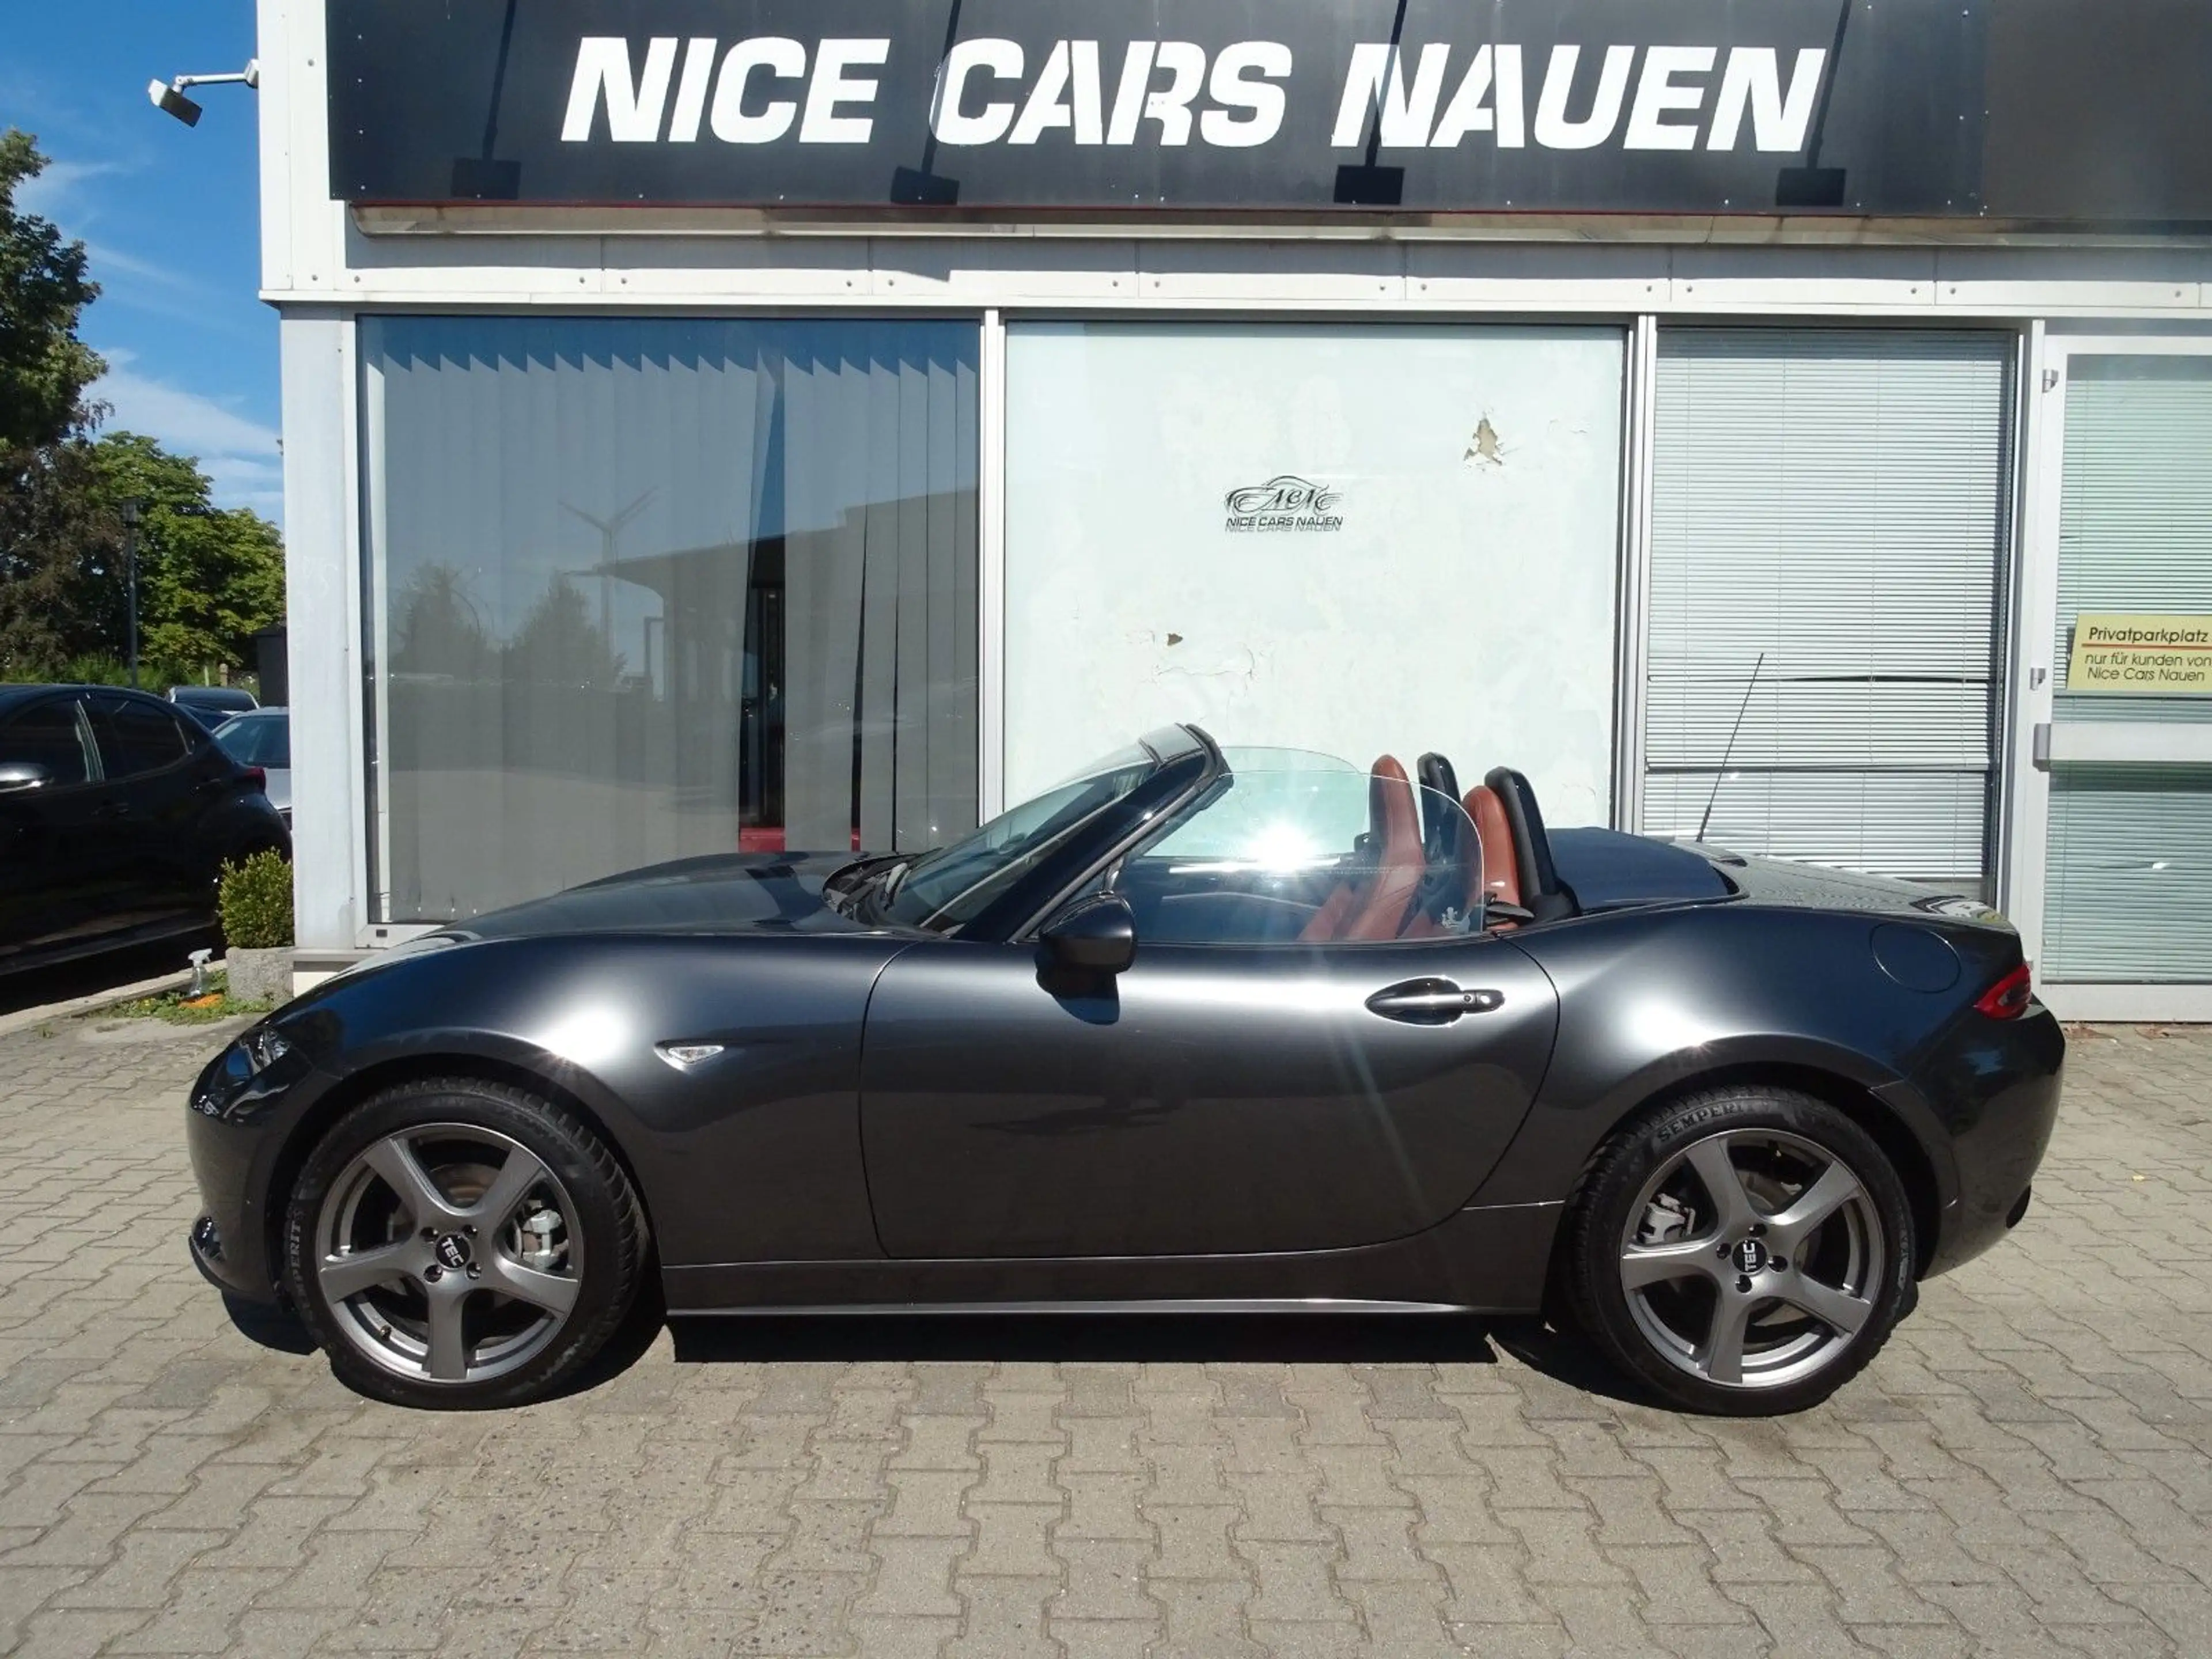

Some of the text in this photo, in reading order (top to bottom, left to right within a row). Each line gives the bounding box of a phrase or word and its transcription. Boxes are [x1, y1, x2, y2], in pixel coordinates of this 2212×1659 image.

[561, 37, 1826, 152] NICE CARS NAUEN
[1226, 516, 1343, 526] NICE CARS NAUEN
[2088, 627, 2209, 644] Privatparkplatz
[2085, 652, 2212, 668] nur für kunden von
[2088, 667, 2205, 682] Nice Cars Nauen
[442, 1237, 464, 1267] TEC
[1743, 1243, 1757, 1271] TEC
